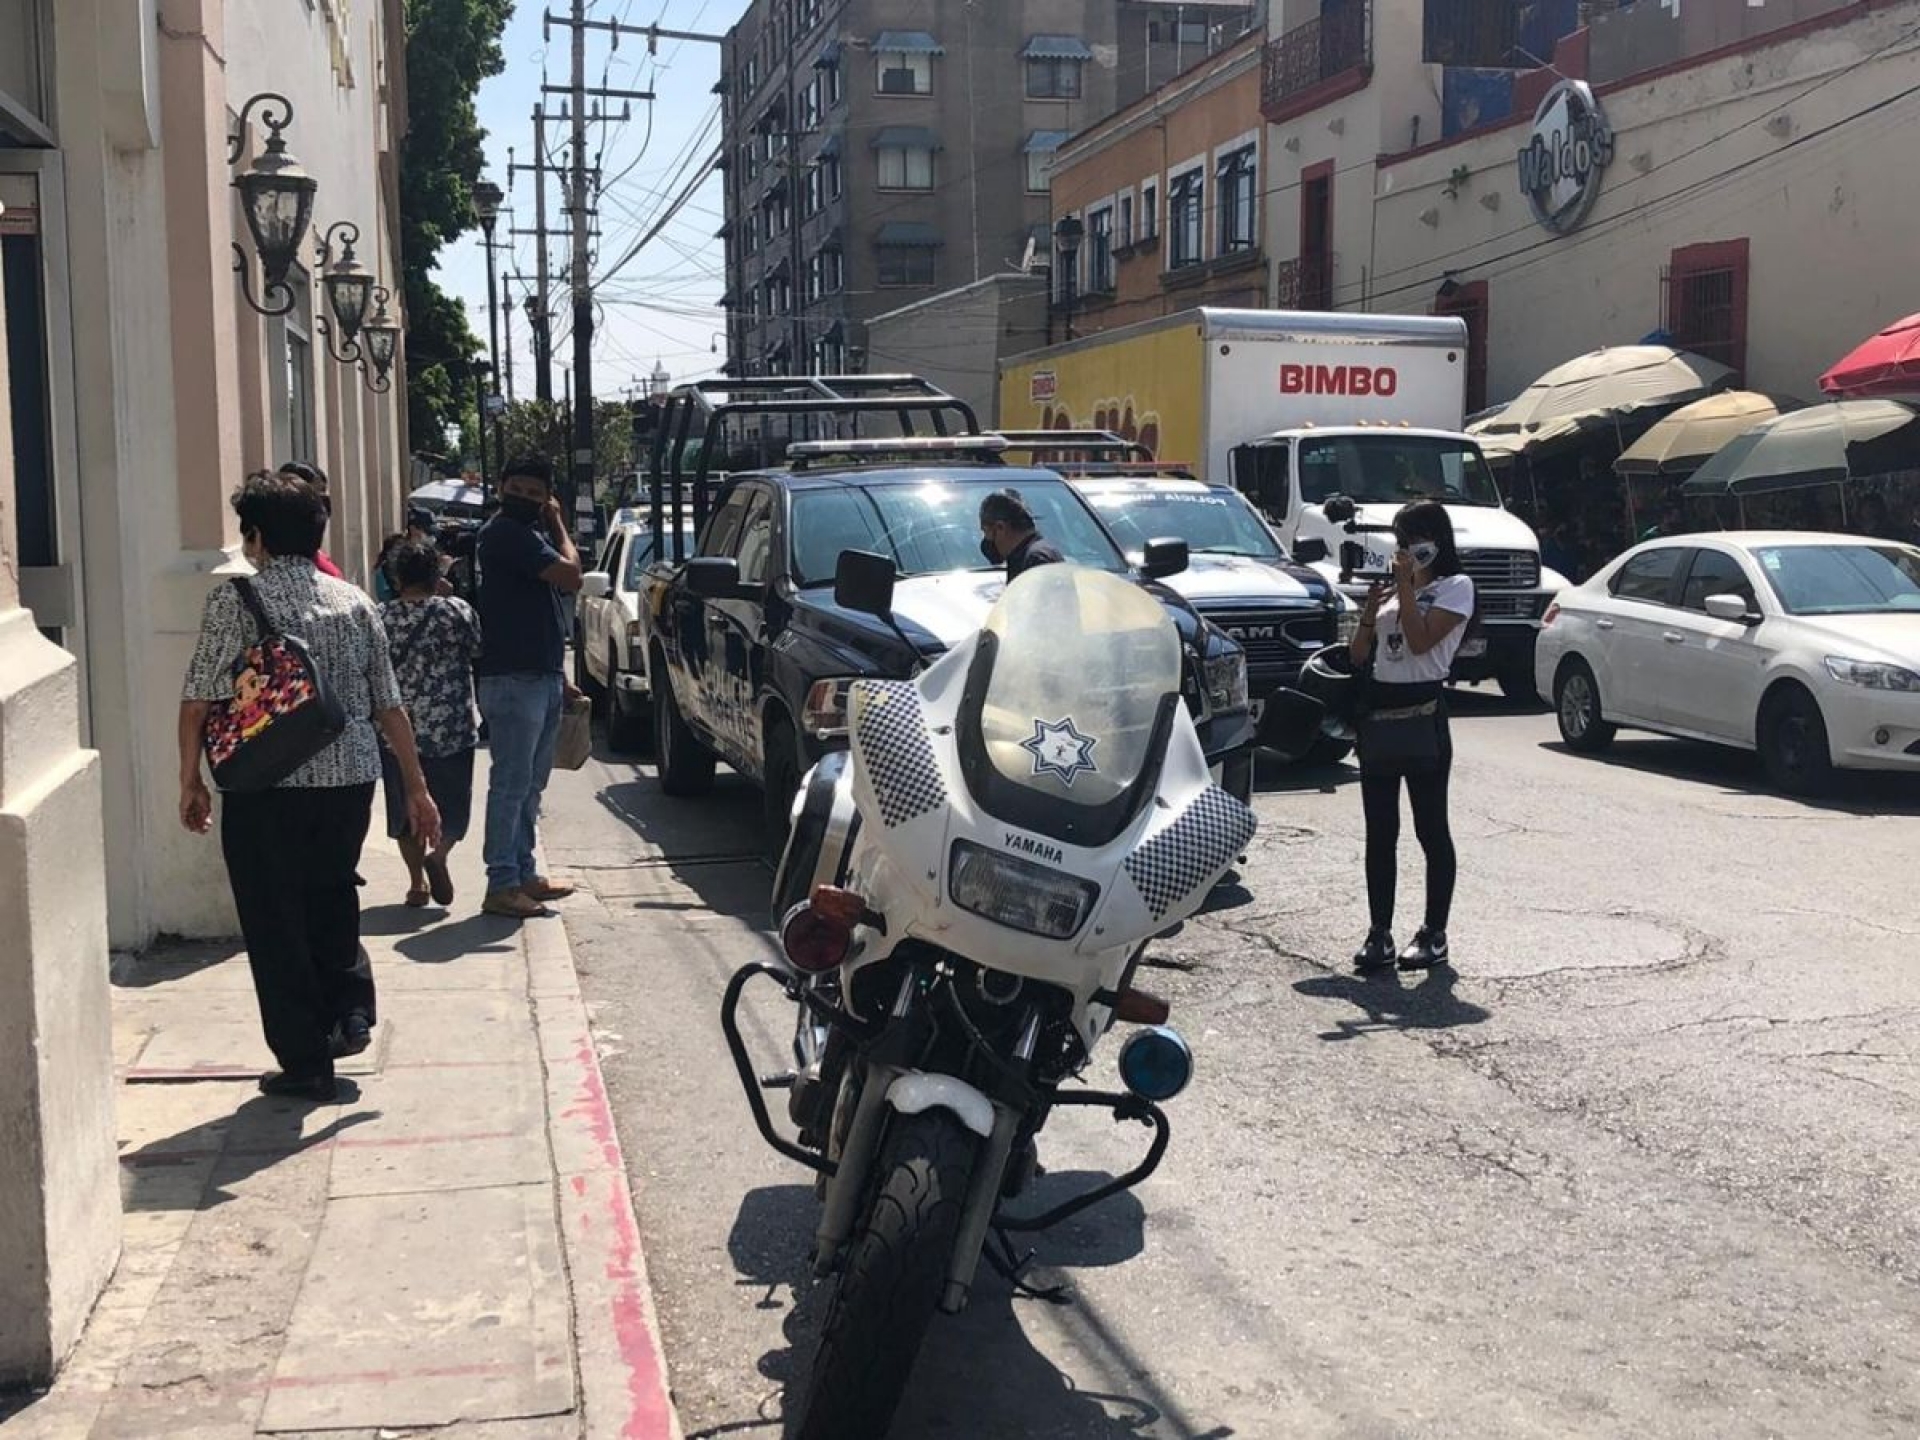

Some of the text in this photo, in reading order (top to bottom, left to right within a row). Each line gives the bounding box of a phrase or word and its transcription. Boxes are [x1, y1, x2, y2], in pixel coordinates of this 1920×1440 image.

[1518, 120, 1614, 195] Waldo's
[1280, 364, 1396, 396] BIMBO
[1225, 626, 1274, 639] AM
[1004, 832, 1063, 864] YAMAHA
